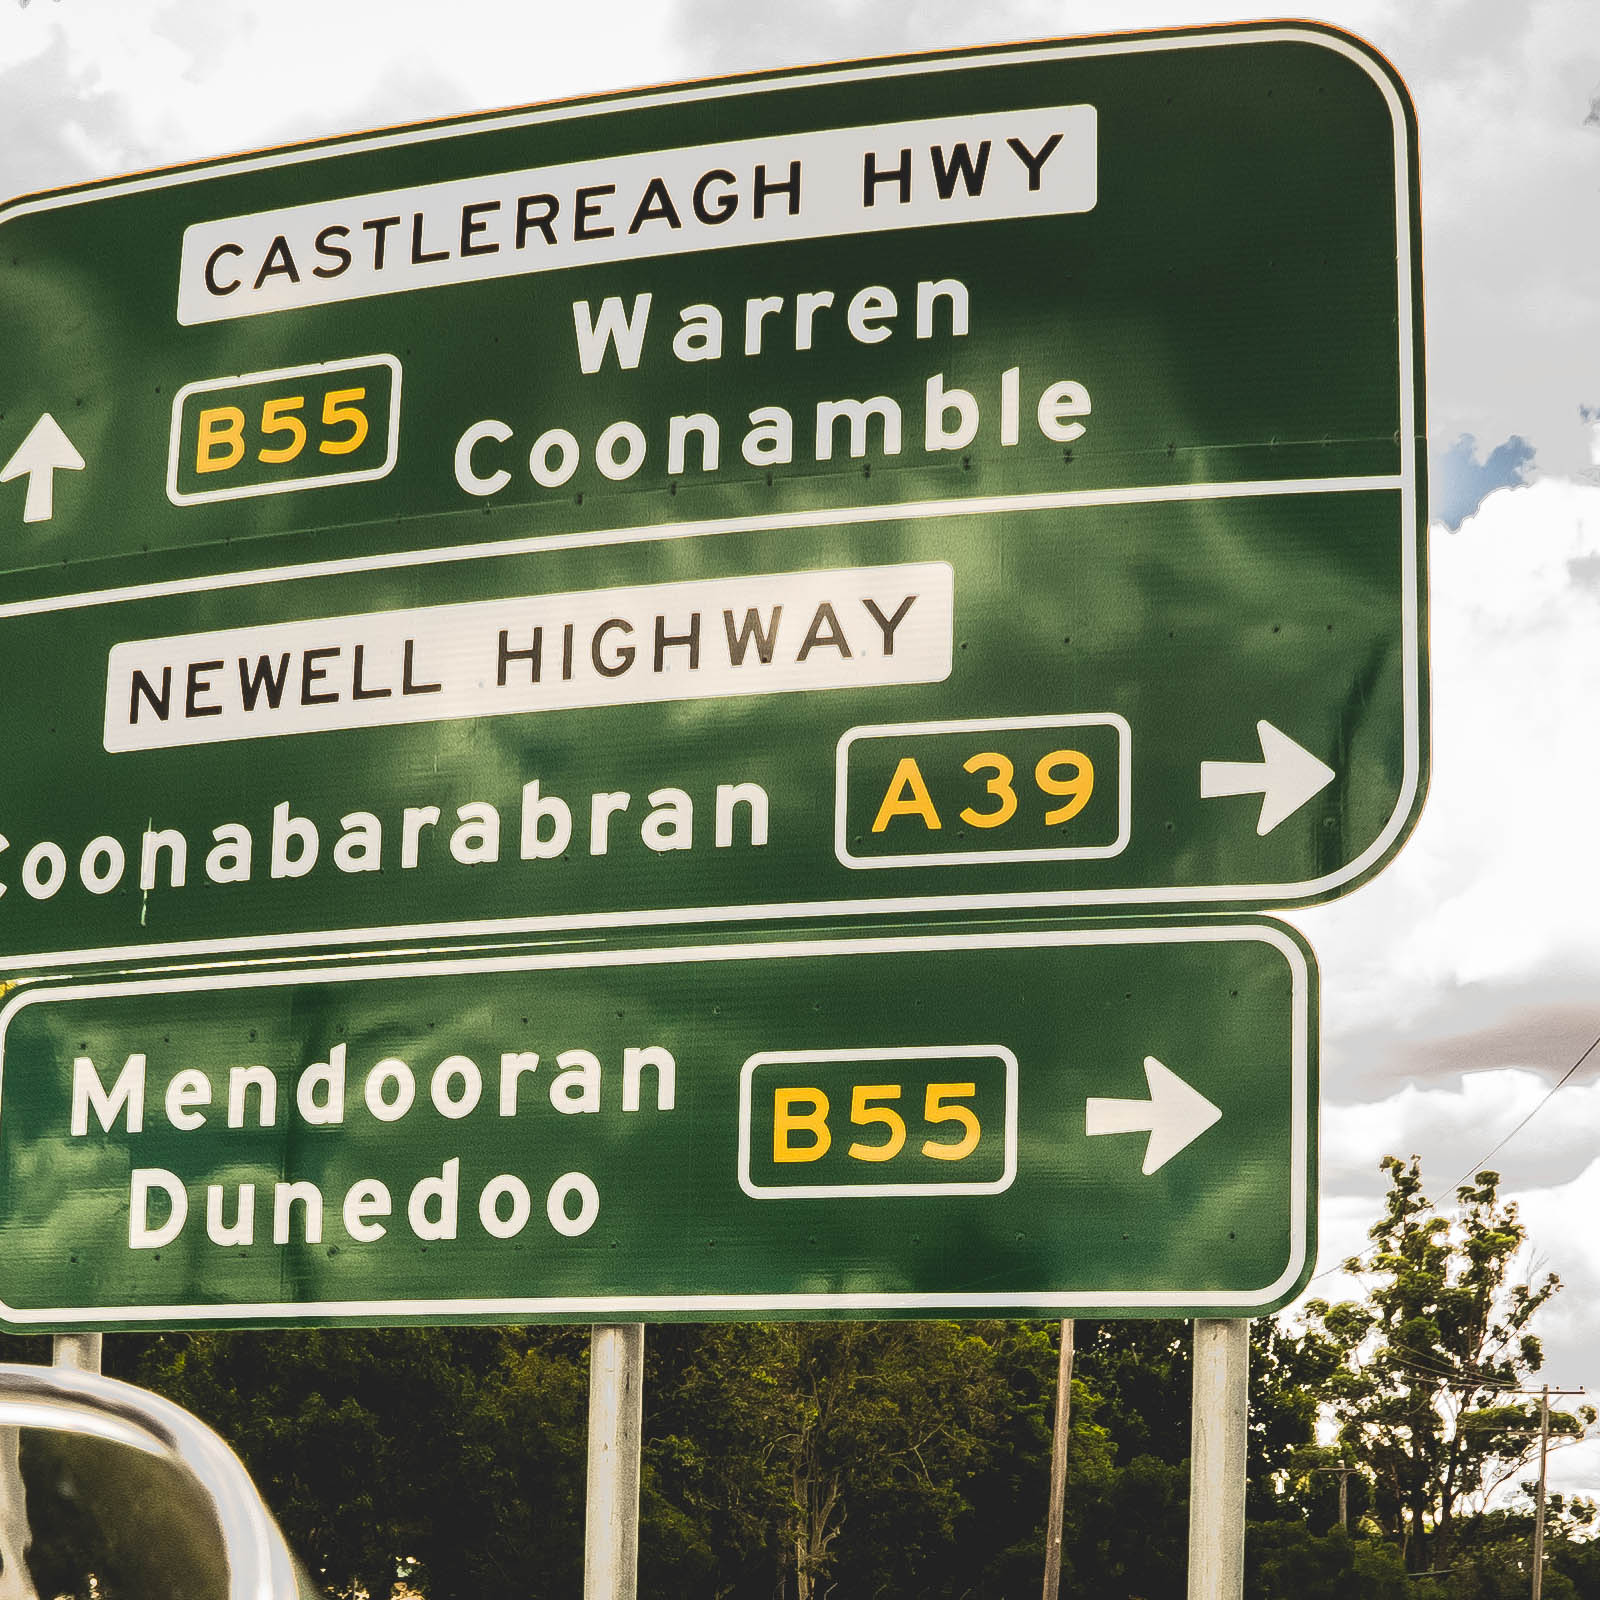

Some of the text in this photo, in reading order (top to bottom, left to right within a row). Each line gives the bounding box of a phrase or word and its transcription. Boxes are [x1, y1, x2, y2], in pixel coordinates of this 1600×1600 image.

[203, 133, 1065, 297] CASTLEREAGH HWY
[571, 278, 970, 375] Warren
[195, 386, 370, 475] B55
[453, 365, 1093, 497] Coonamble
[128, 595, 917, 726] NEWELL HIGHWAY
[870, 748, 1096, 834] A39
[69, 1041, 677, 1138] Mendooran
[772, 1081, 982, 1164] B55
[127, 1155, 601, 1251] Dunedoo
